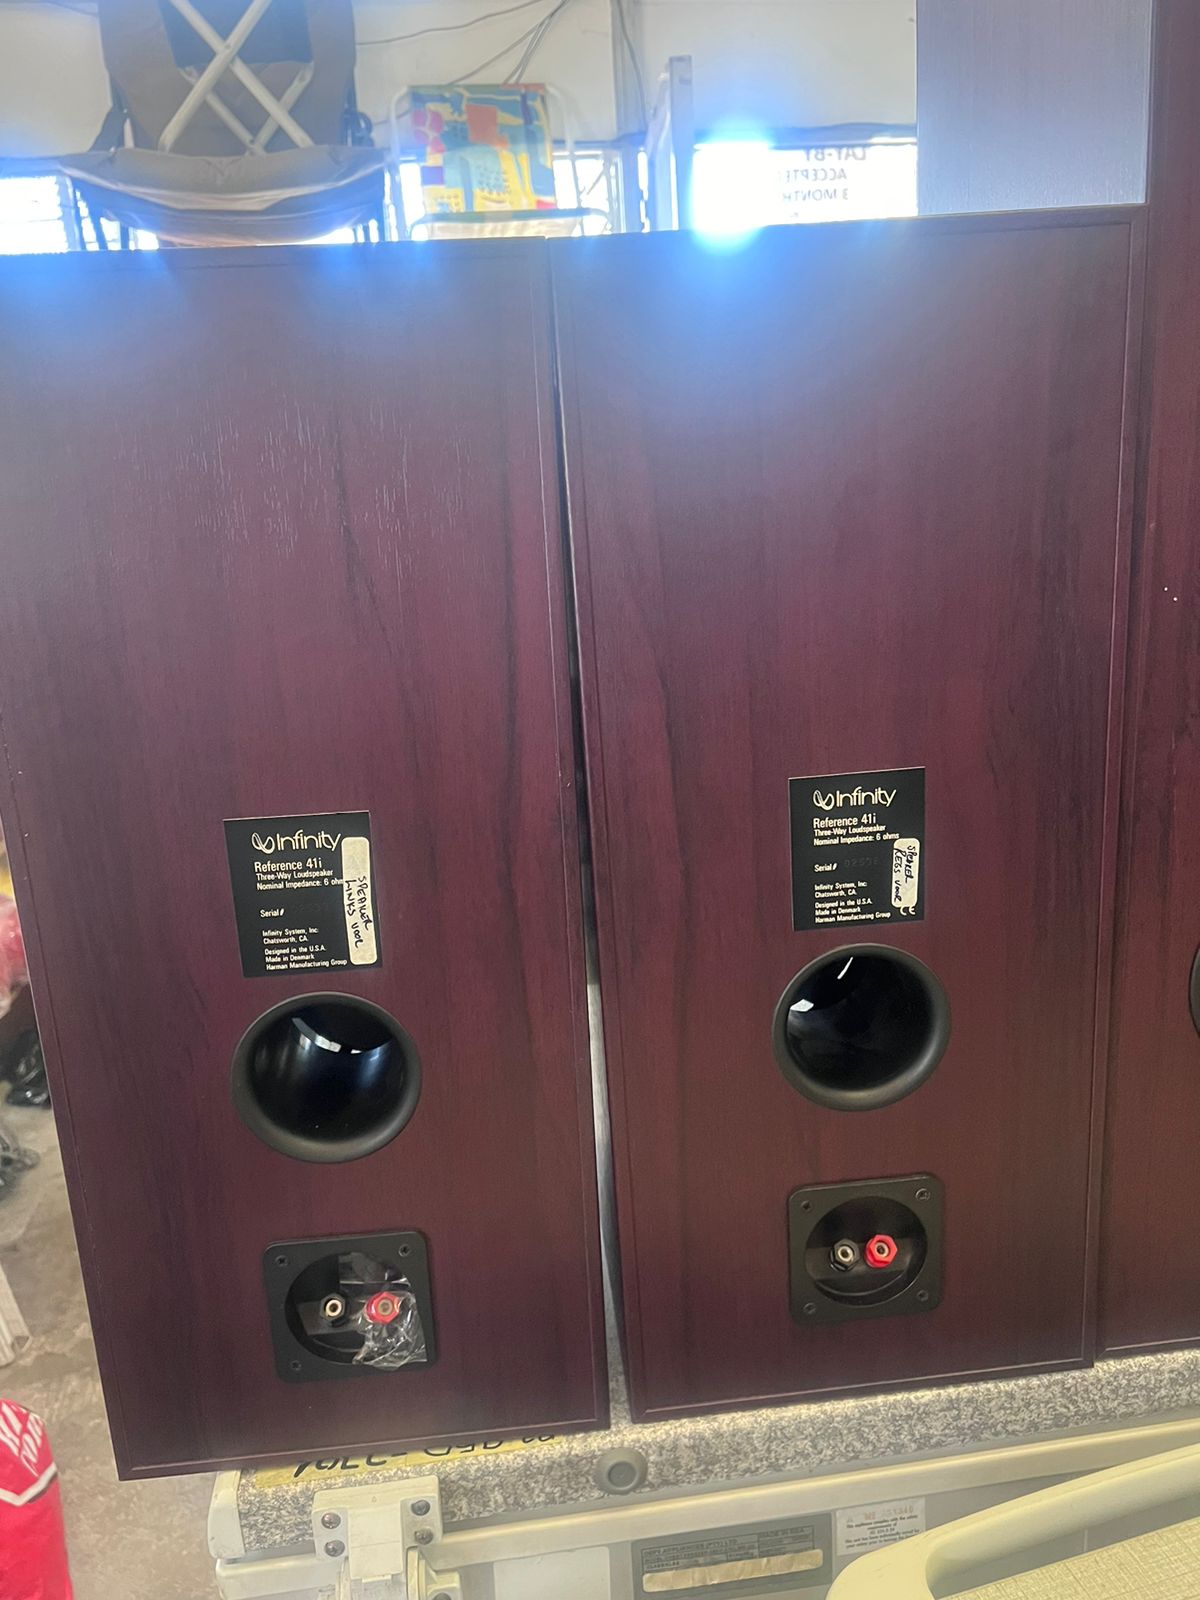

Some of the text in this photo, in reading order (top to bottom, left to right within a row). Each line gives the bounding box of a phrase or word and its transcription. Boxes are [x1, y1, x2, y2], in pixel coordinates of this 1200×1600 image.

[837, 787, 896, 807] Infinity
[813, 813, 876, 828] Reference 41i
[814, 825, 885, 836] Three-Way Loudspeaker
[277, 829, 341, 851] Infinity
[814, 837, 839, 846] Nominal
[255, 858, 322, 872] Reference 41i
[256, 869, 333, 881] Three-Way Loudspeaker
[257, 882, 284, 890] Nominal
[815, 883, 833, 891] Infinity
[345, 879, 357, 917] LINKS
[358, 875, 373, 931] SPEAKER
[263, 929, 283, 937] Infinity
[265, 948, 289, 956] Designed
[290, 960, 329, 969] Manufacturing
